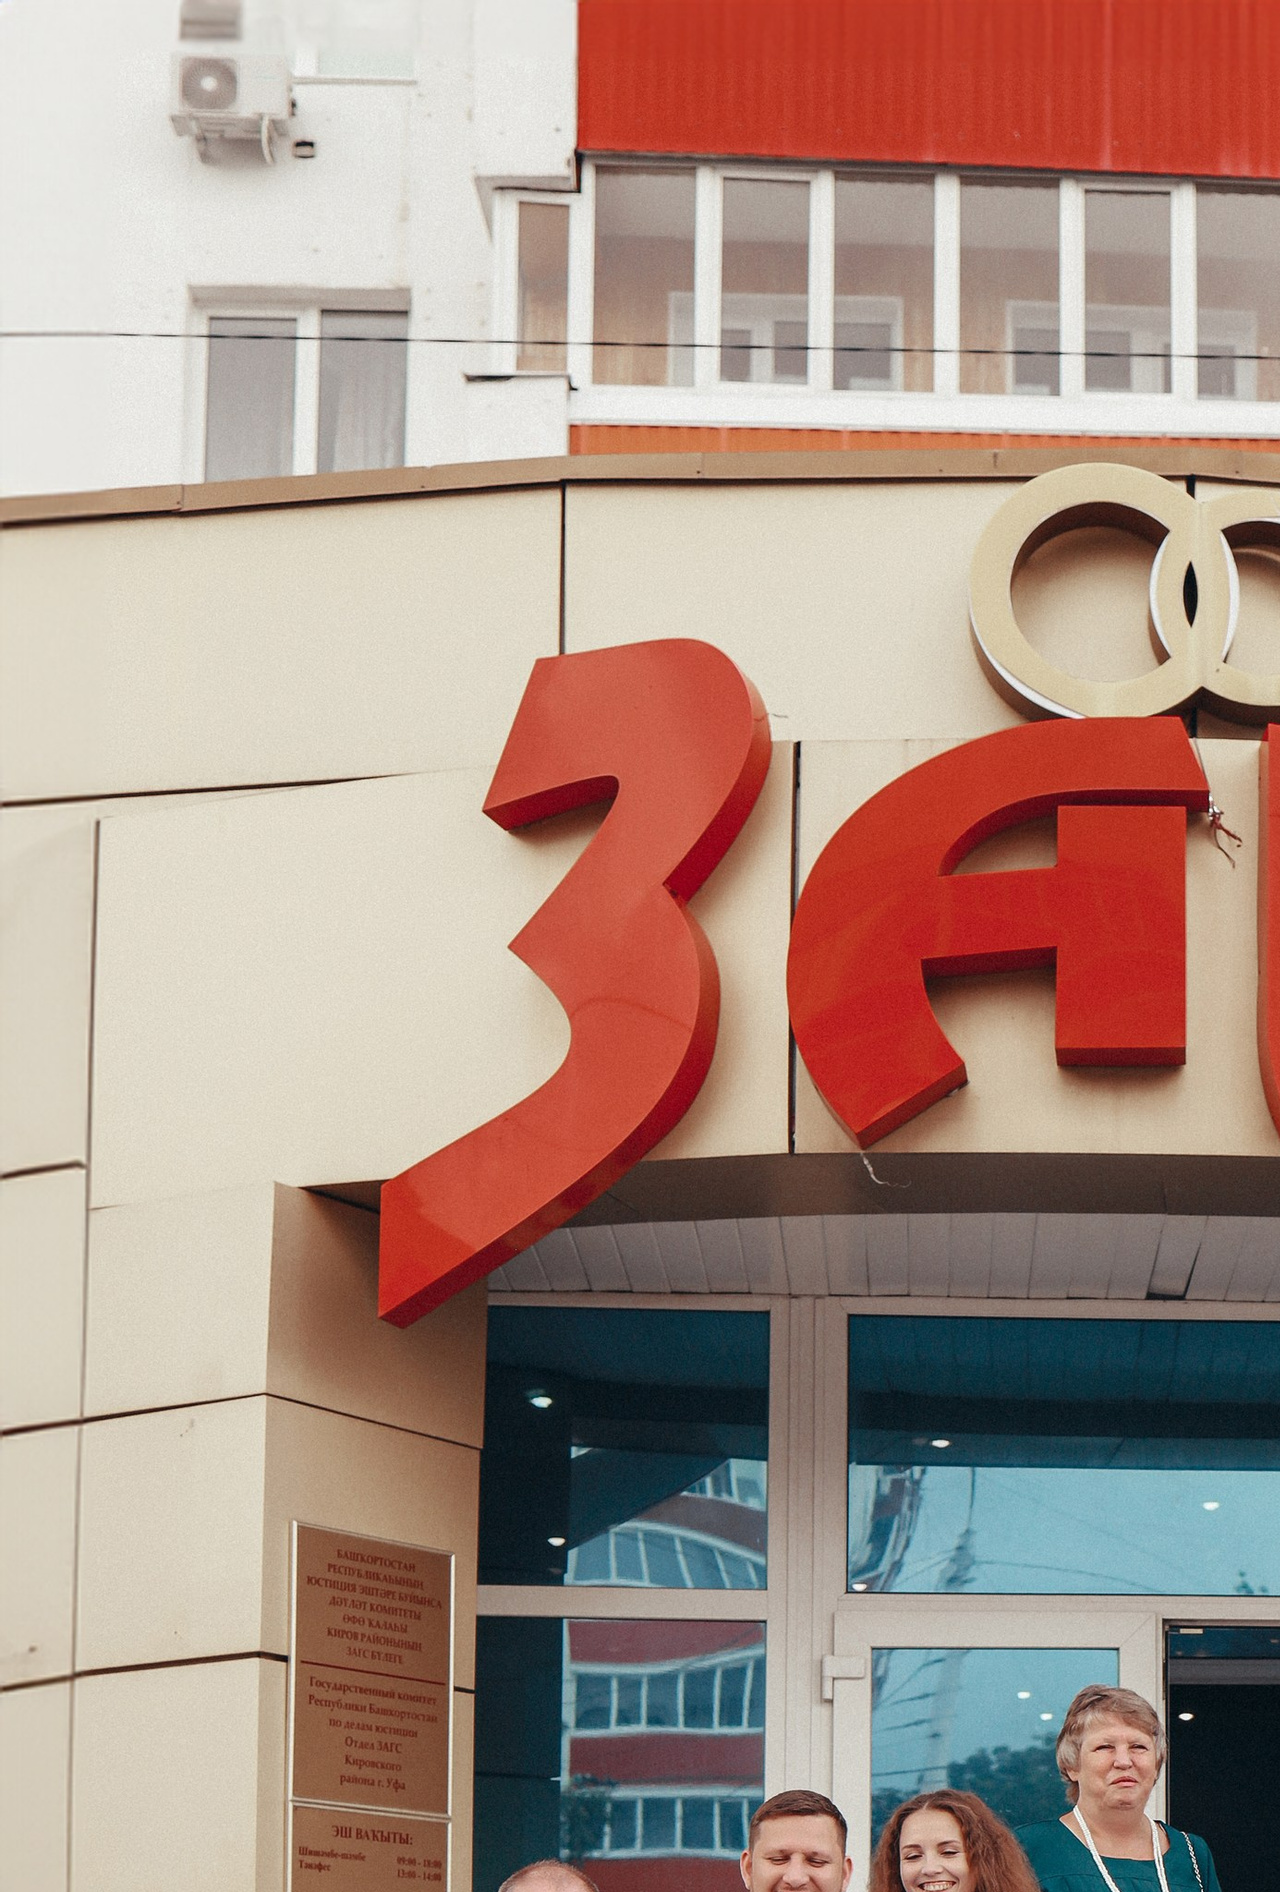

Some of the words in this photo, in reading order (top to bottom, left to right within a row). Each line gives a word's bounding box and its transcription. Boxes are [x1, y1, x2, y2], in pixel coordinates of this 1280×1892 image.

[307, 1576, 356, 1592] ЮСТИЦИЯ
[370, 1603, 421, 1620] КОМИТЕТЫ
[327, 1628, 358, 1641] КИРОВ
[346, 1647, 370, 1657] ЗАГС
[310, 1676, 395, 1699] Государственный
[398, 1694, 437, 1705] комитет
[308, 1695, 366, 1712] Республики
[369, 1704, 438, 1723] Башкортостан
[329, 1718, 341, 1727] по
[344, 1721, 373, 1732] делам
[375, 1725, 418, 1738] юстиции
[345, 1736, 374, 1750] Отдел
[377, 1741, 402, 1753] ЗАГС
[345, 1755, 402, 1772] Кировского
[340, 1774, 375, 1786] района
[386, 1779, 406, 1792] Уфа
[332, 1825, 352, 1838] ЭШ
